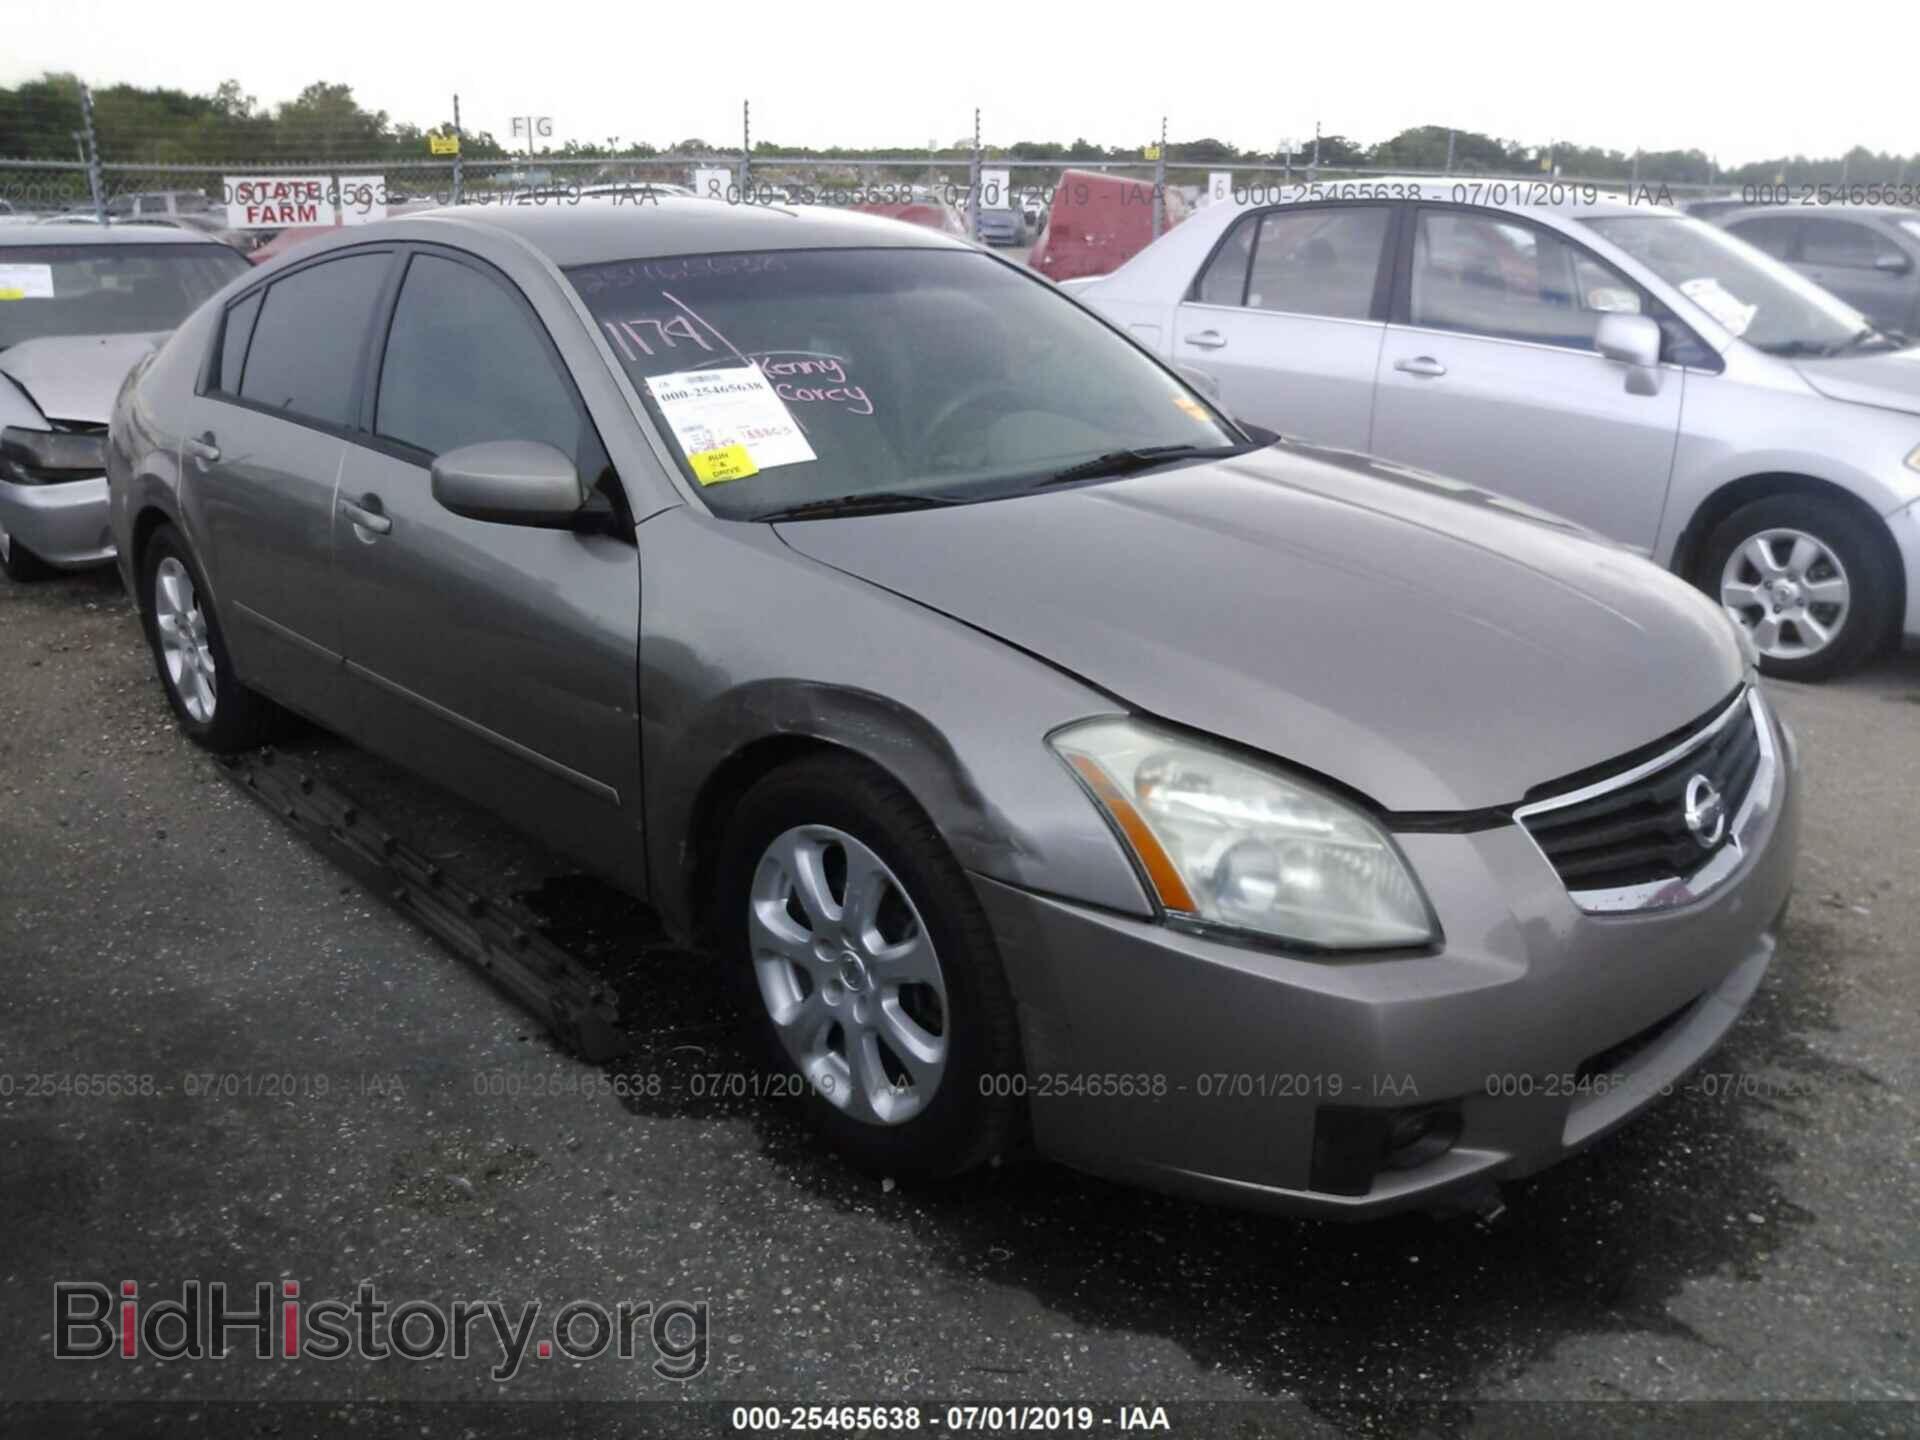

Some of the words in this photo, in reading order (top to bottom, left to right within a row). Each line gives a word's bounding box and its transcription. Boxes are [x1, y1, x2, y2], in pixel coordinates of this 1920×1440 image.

[512, 117, 523, 137] F
[537, 117, 553, 137] G
[240, 182, 320, 200] STATE
[247, 205, 317, 223] FARM
